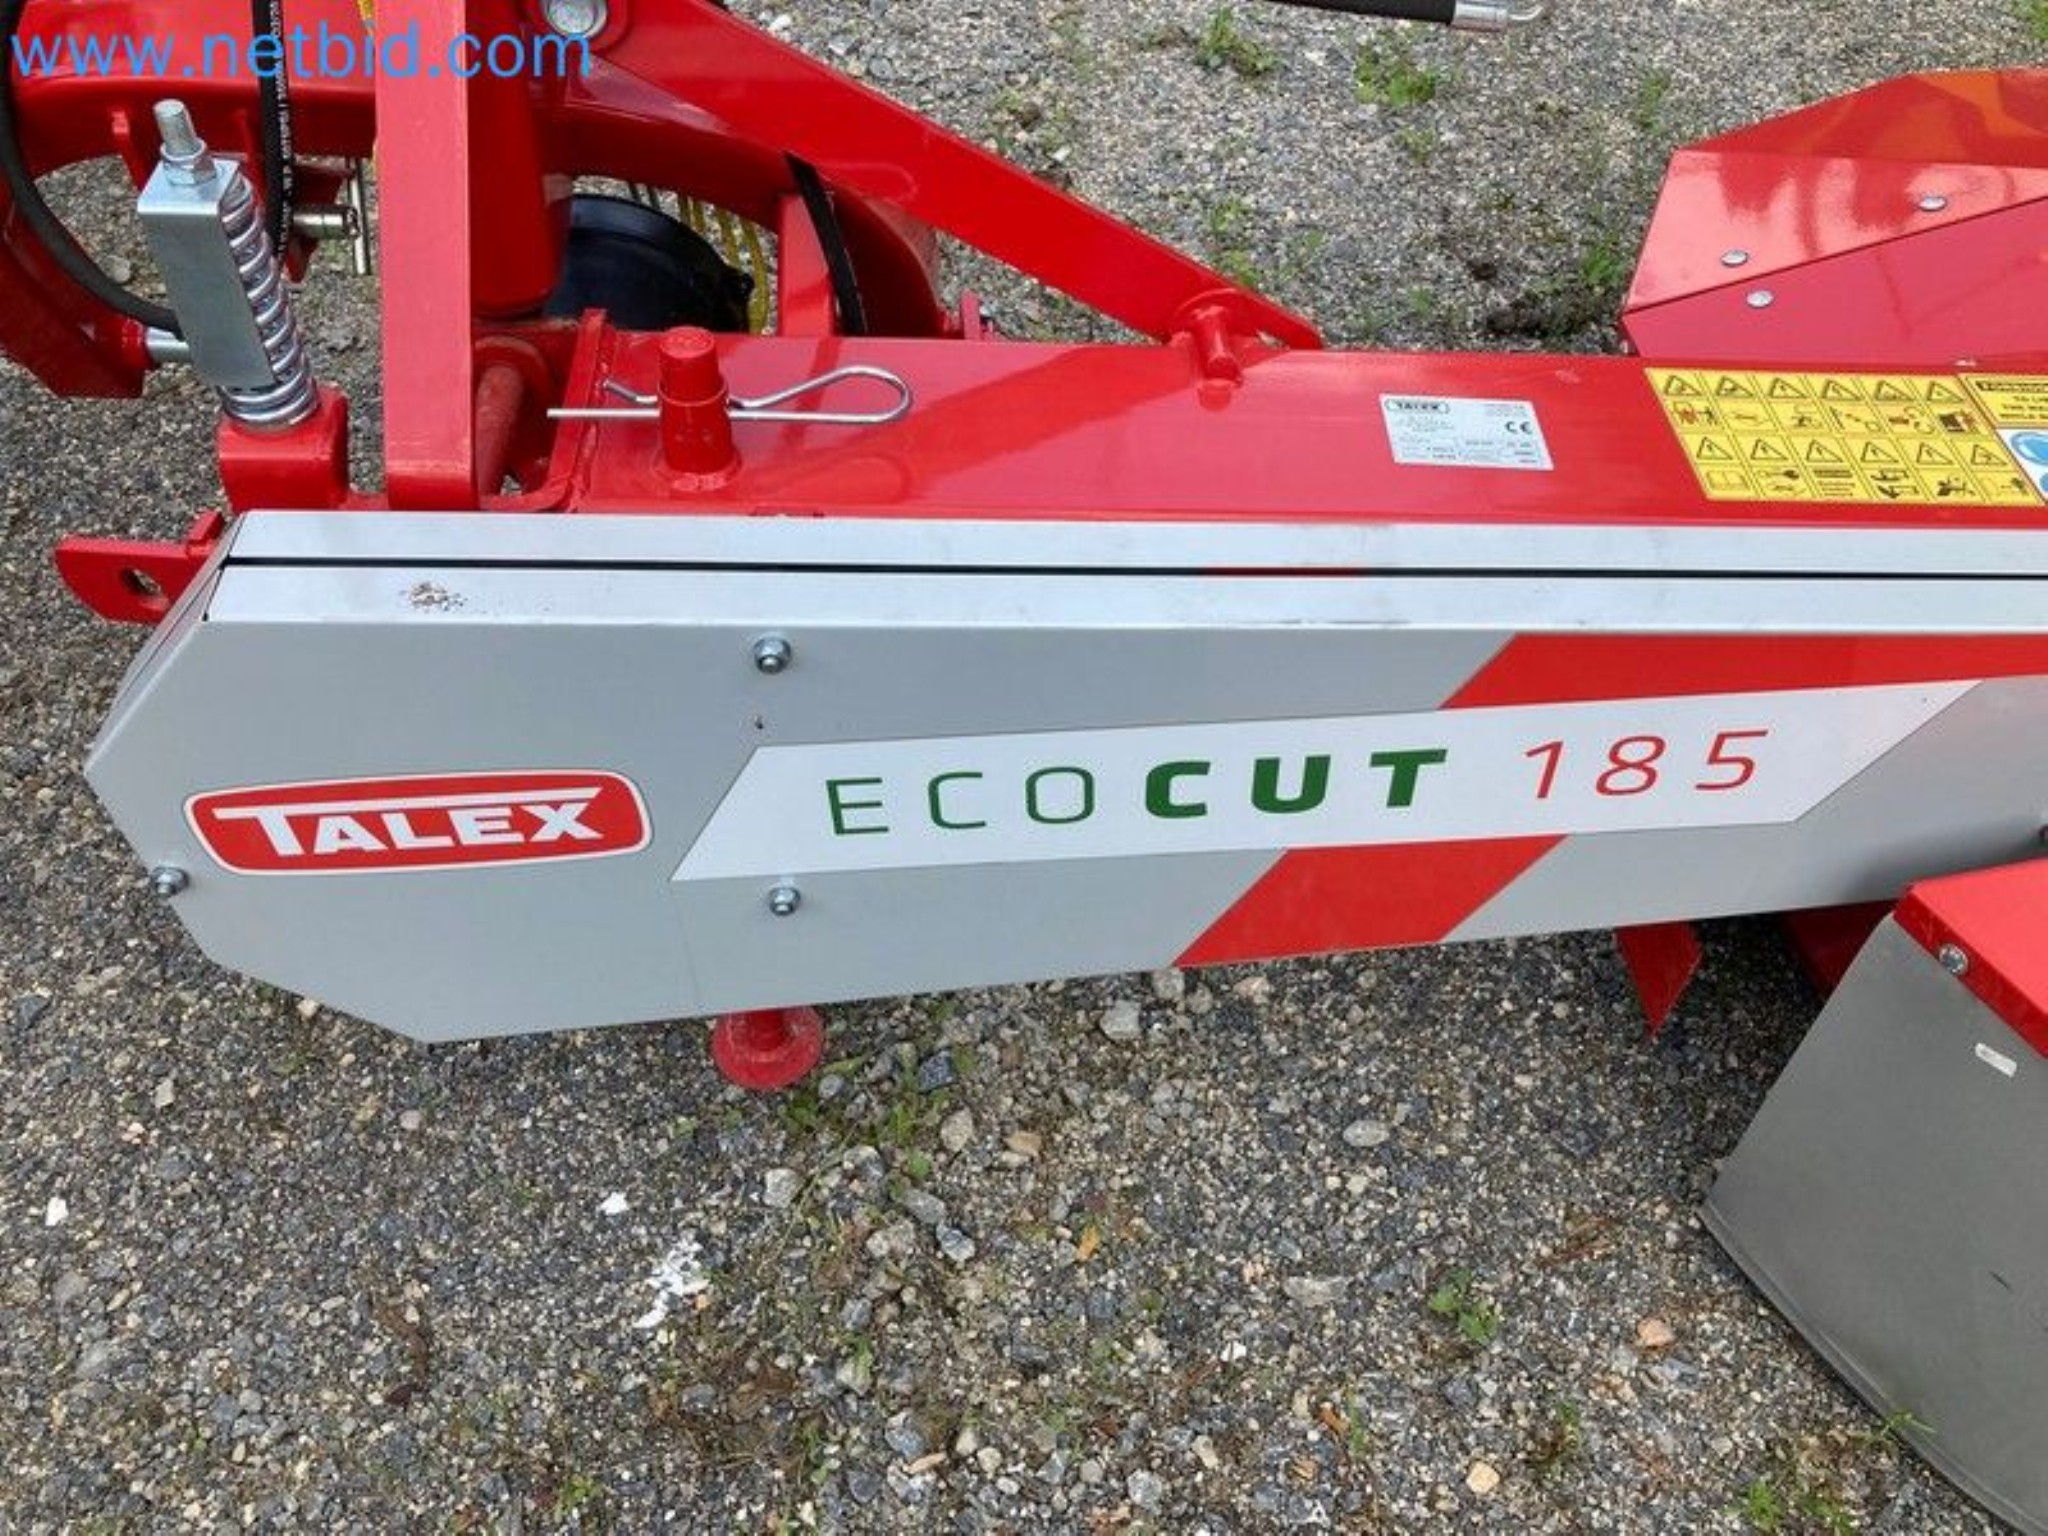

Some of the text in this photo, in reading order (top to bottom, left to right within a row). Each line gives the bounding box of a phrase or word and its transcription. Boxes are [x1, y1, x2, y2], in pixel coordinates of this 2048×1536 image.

[212, 787, 603, 857] TALEX
[826, 729, 1769, 835] ECOCUT 185
